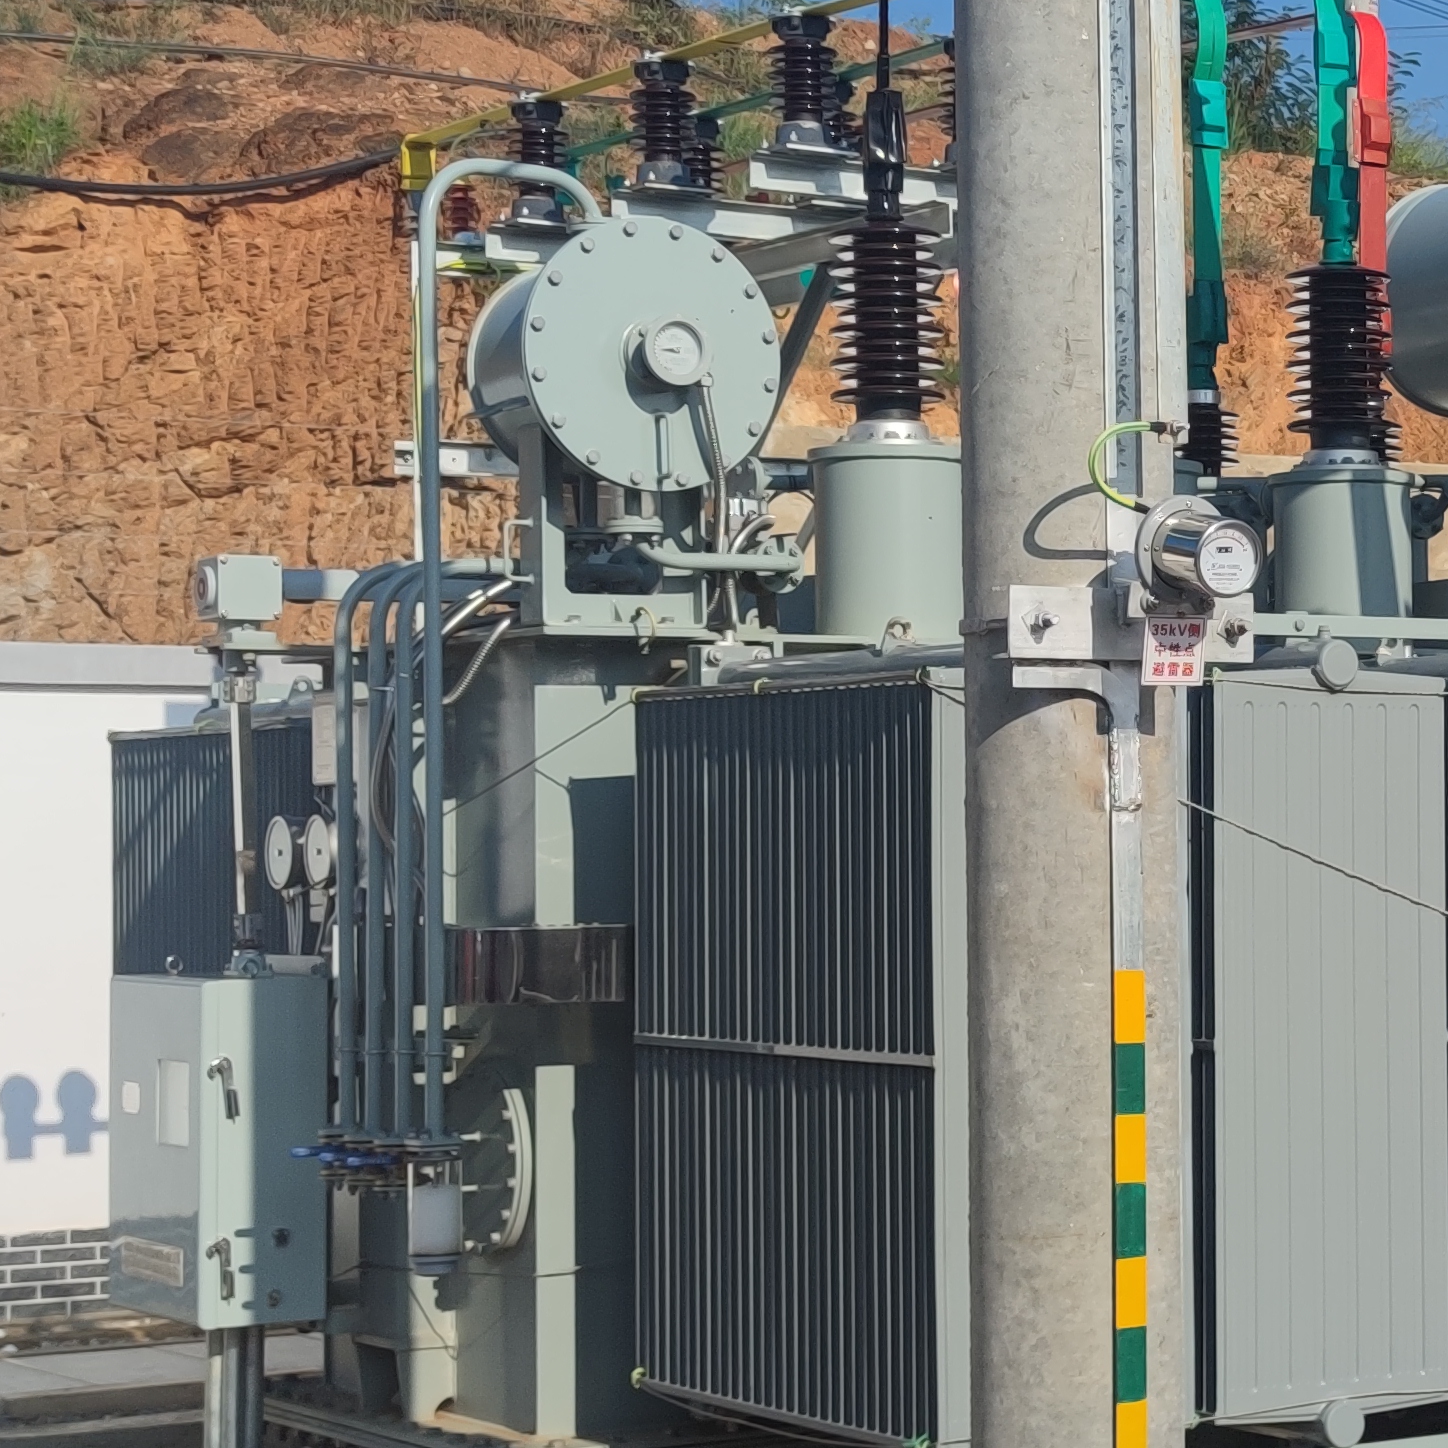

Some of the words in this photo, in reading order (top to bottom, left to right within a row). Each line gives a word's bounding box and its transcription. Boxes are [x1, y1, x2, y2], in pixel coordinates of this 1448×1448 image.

[1151, 623, 1201, 638] 35kV侧
[1154, 641, 1195, 657] 中性点
[1152, 661, 1194, 677] 避雷器
